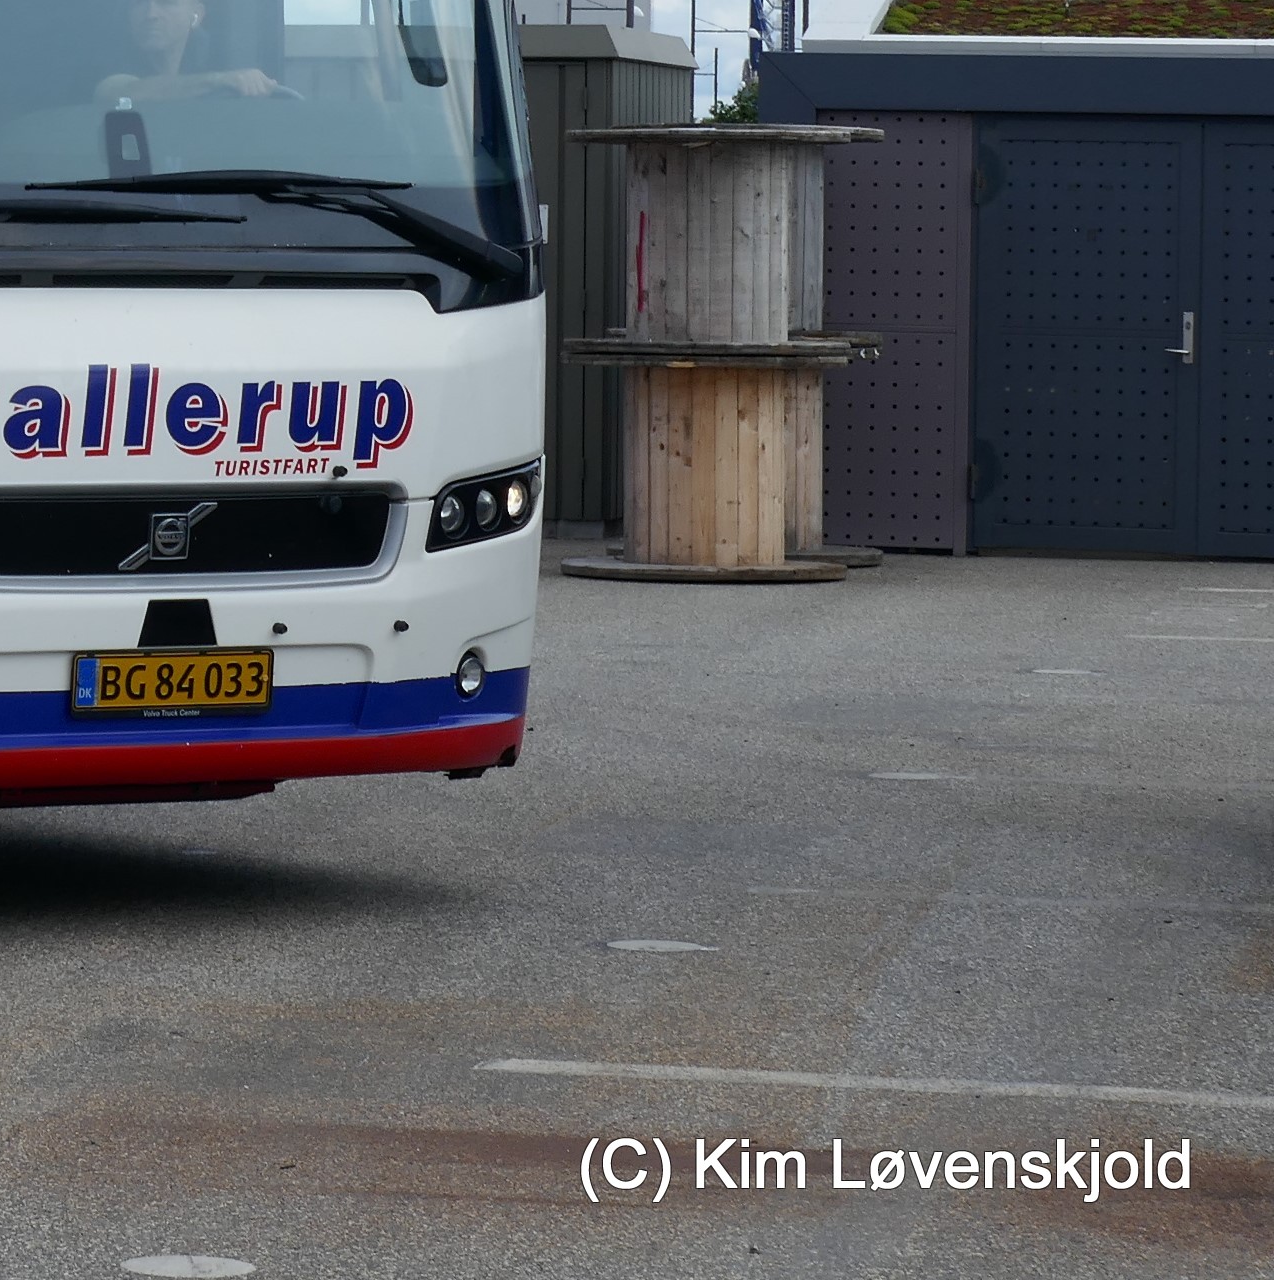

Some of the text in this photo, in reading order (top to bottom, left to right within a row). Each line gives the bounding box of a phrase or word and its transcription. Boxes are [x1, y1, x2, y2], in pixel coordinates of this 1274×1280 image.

[215, 458, 330, 477] TURISTFART
[101, 661, 264, 701] BG 84 033
[78, 686, 92, 700] DK
